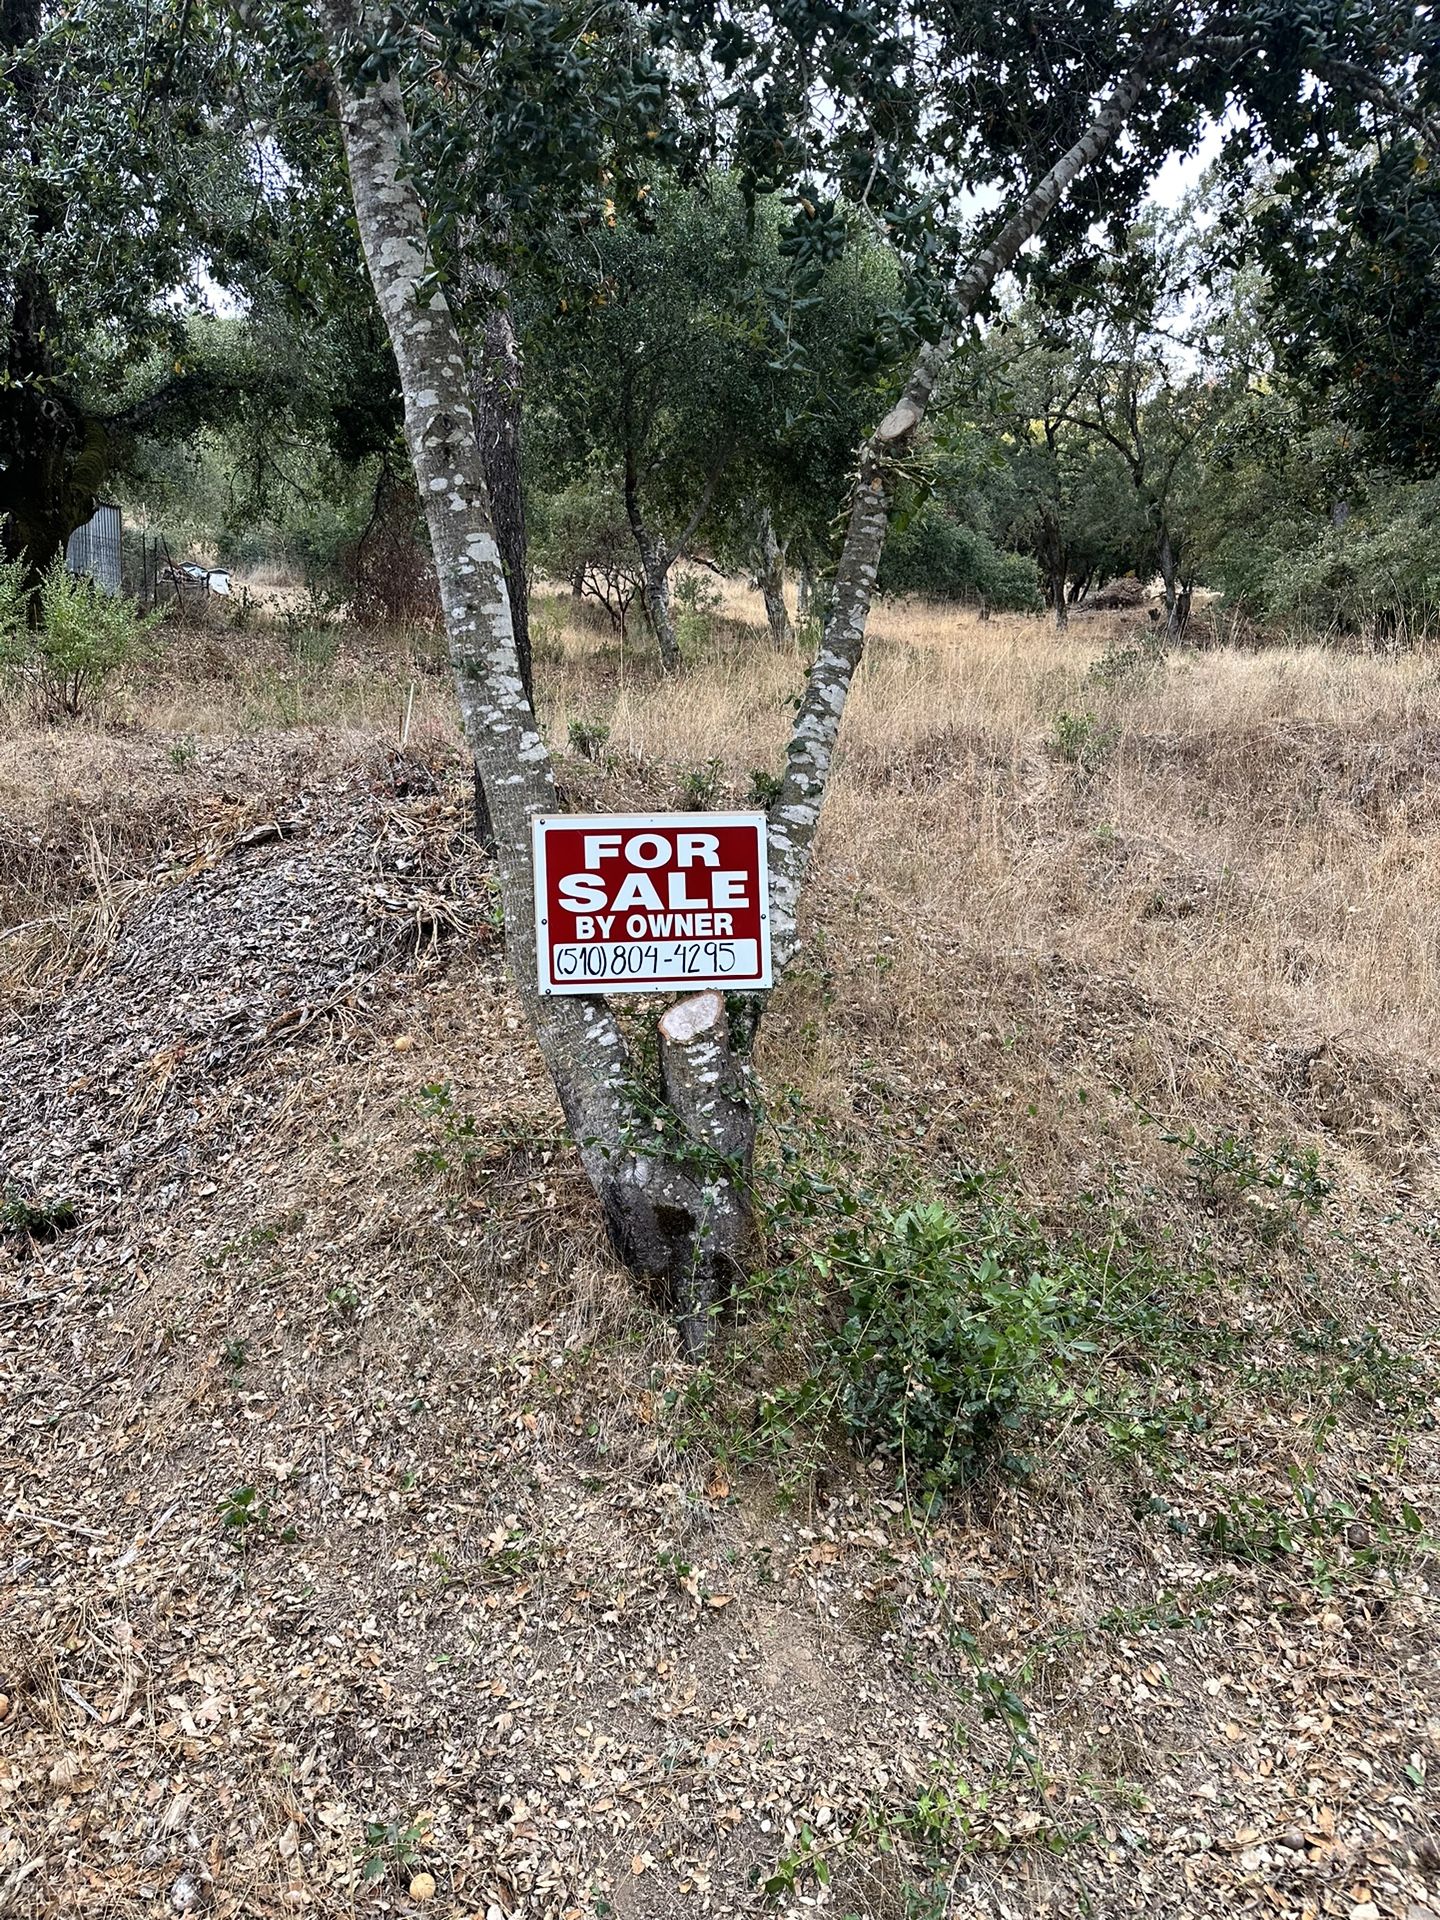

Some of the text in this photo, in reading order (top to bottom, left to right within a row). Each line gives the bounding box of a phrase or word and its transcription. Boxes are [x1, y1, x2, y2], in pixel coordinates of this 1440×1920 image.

[584, 833, 720, 869] FOR
[558, 871, 749, 913] SALE
[575, 913, 733, 939] BY OWNER
